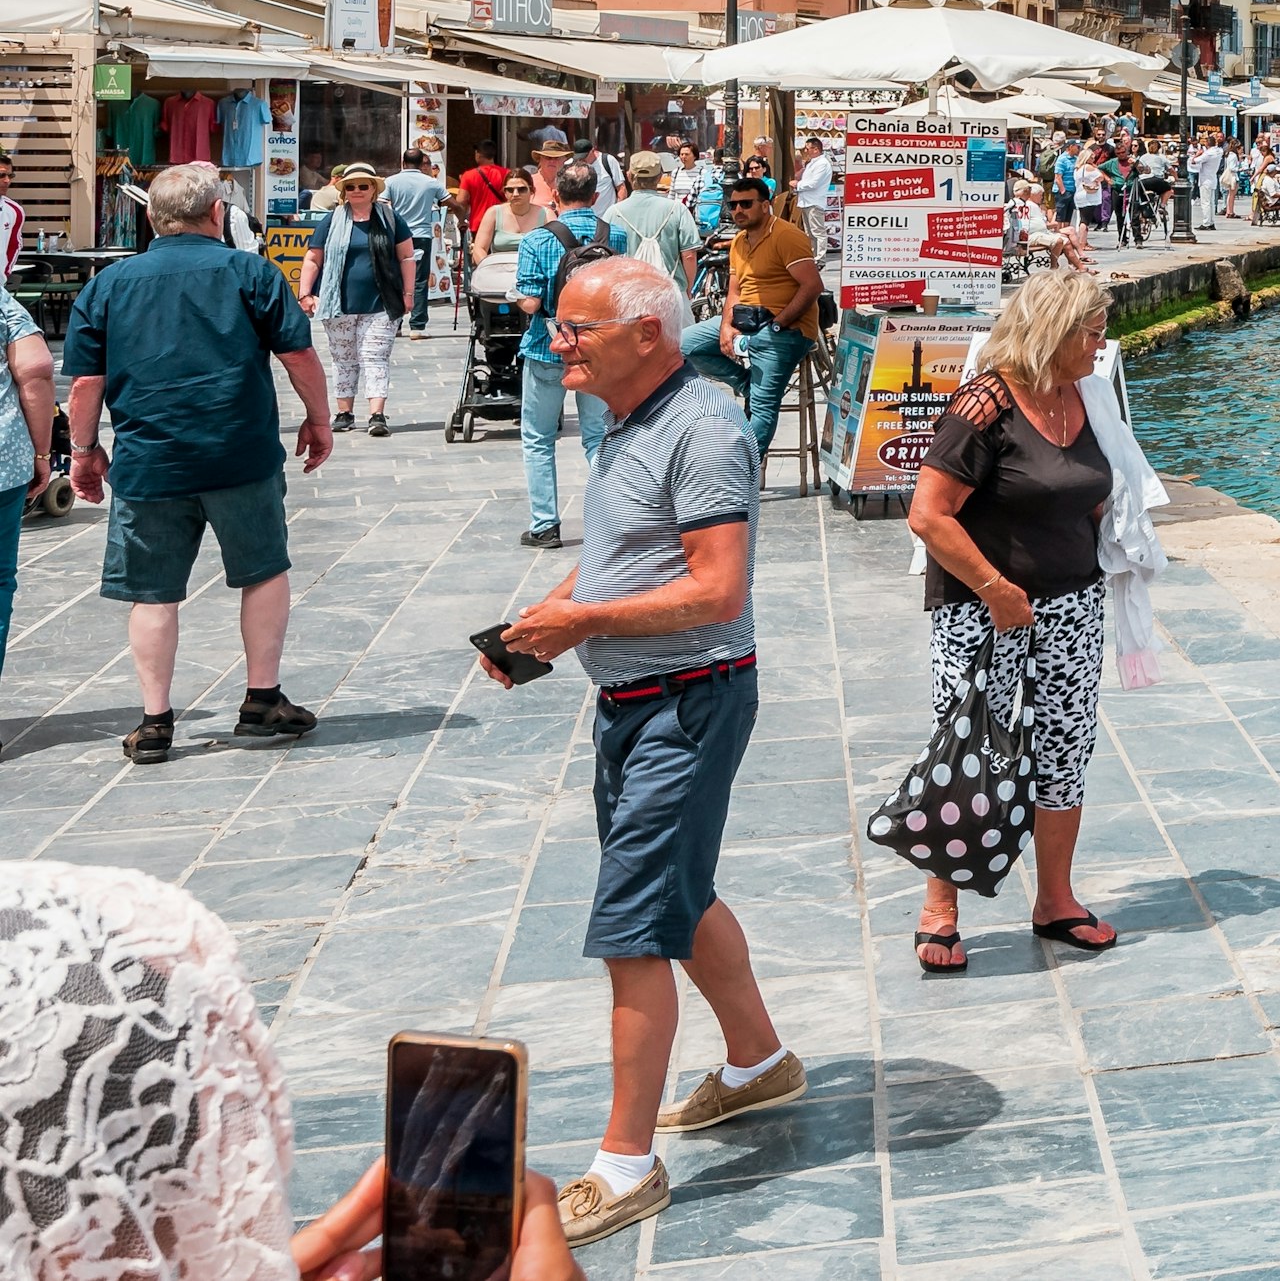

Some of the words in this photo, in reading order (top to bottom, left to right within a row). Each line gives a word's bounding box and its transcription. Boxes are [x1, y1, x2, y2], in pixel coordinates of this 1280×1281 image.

[737, 15, 764, 44] THOS
[855, 118, 910, 132] Chania
[916, 120, 951, 134] Boat
[960, 121, 1000, 137] Trips
[268, 136, 297, 145] GYROS
[857, 137, 891, 146] GLASS
[895, 138, 936, 147] BOTTOM
[940, 140, 967, 148] BOAT
[853, 152, 964, 166] ALEXANDROS
[860, 178, 886, 188] fish
[889, 175, 923, 187] show
[273, 185, 296, 193] Squid
[861, 189, 888, 199] tour
[893, 186, 930, 199] guide
[939, 178, 953, 201] 1
[960, 190, 1000, 202] hour
[847, 216, 908, 228] EROFILI
[956, 213, 998, 223] snorkeling
[936, 223, 954, 231] free
[956, 222, 977, 230] drink
[956, 229, 978, 237] fresh
[980, 227, 1002, 235] fruits
[269, 233, 312, 247] ATM
[847, 234, 864, 244] 2,5
[846, 244, 864, 253] 3,5
[846, 253, 864, 262] 2,5
[867, 254, 882, 262] hrs
[930, 247, 949, 256] free
[951, 250, 998, 263] snorkeling
[849, 270, 916, 278] EVAGGELLOS
[938, 324, 964, 332] Boat
[965, 324, 991, 333] Trips
[931, 364, 964, 374] SUNS
[869, 393, 875, 402] 1
[877, 393, 909, 402] HOUR
[910, 393, 952, 402] SUNSET
[898, 406, 926, 416] FREE
[927, 406, 945, 416] DRI
[876, 421, 903, 430] FREE
[885, 446, 931, 460] PRIV
[887, 483, 916, 492] info@ch
